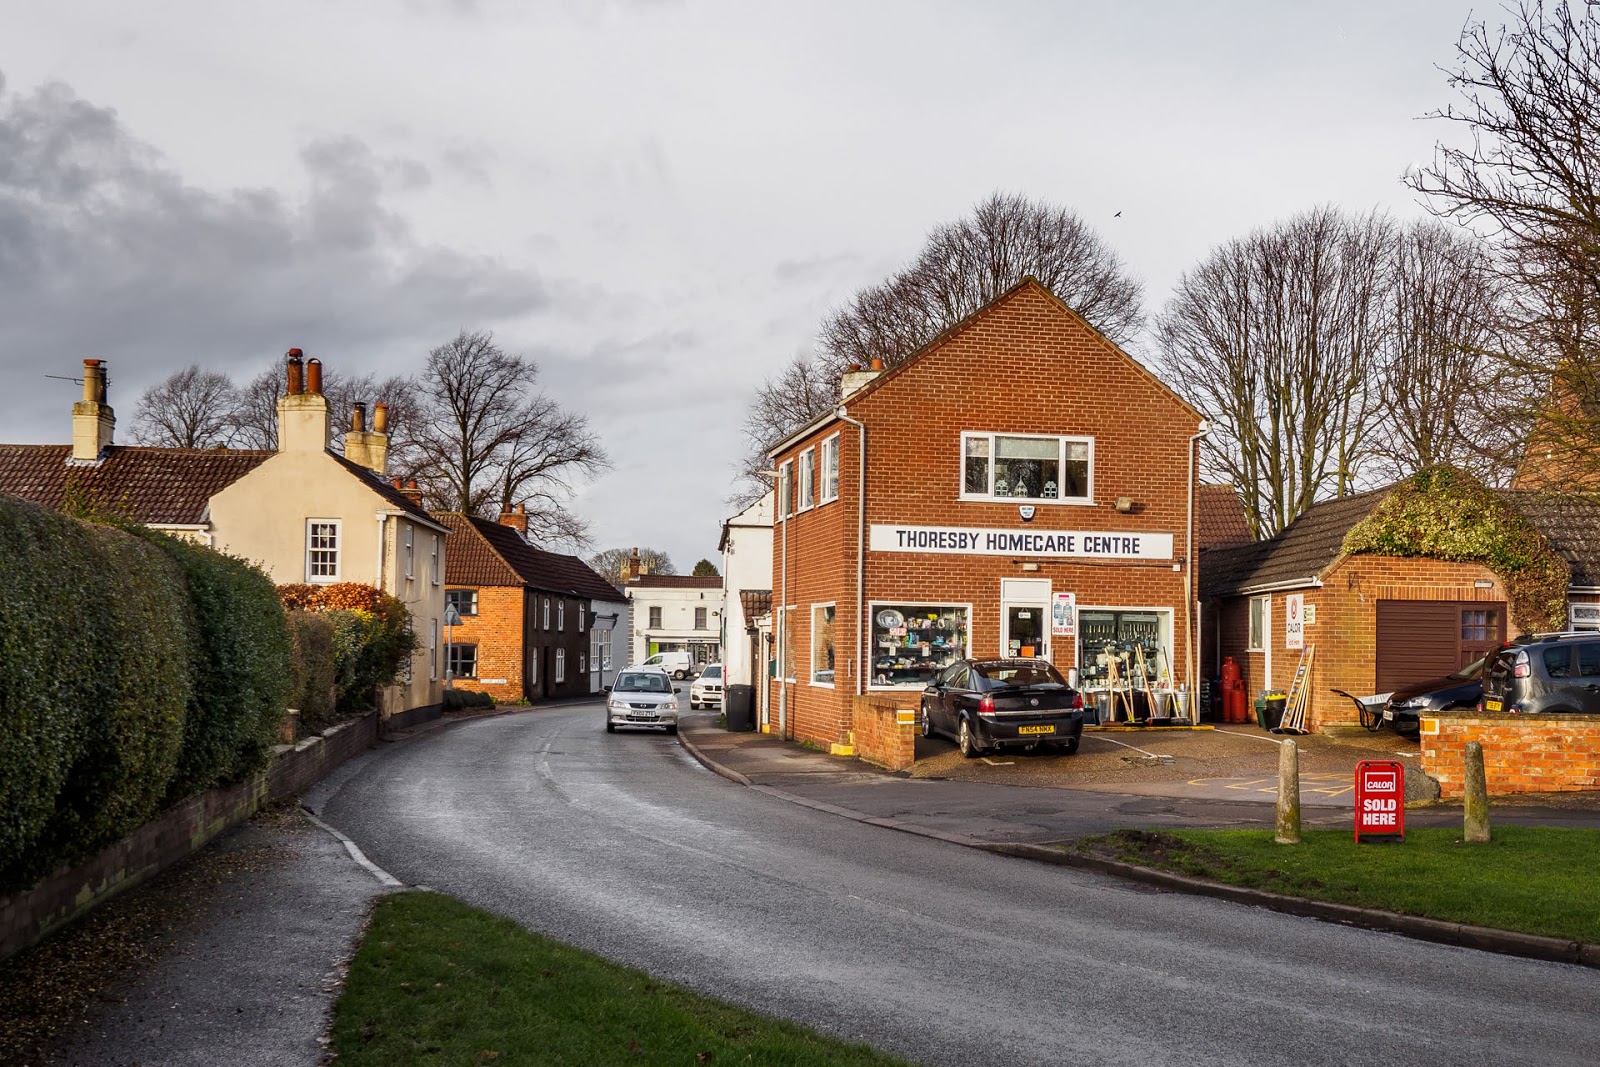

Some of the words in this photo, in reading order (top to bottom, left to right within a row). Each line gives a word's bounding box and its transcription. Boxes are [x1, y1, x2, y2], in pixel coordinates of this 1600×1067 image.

[896, 530, 980, 550] THORESBY
[986, 533, 1075, 553] HOMECARE
[1083, 536, 1141, 554] CENTRE
[1288, 622, 1301, 633] CALOR
[1367, 781, 1393, 790] CALOR
[1363, 798, 1397, 812] SOLD
[1362, 812, 1396, 826] HERE
